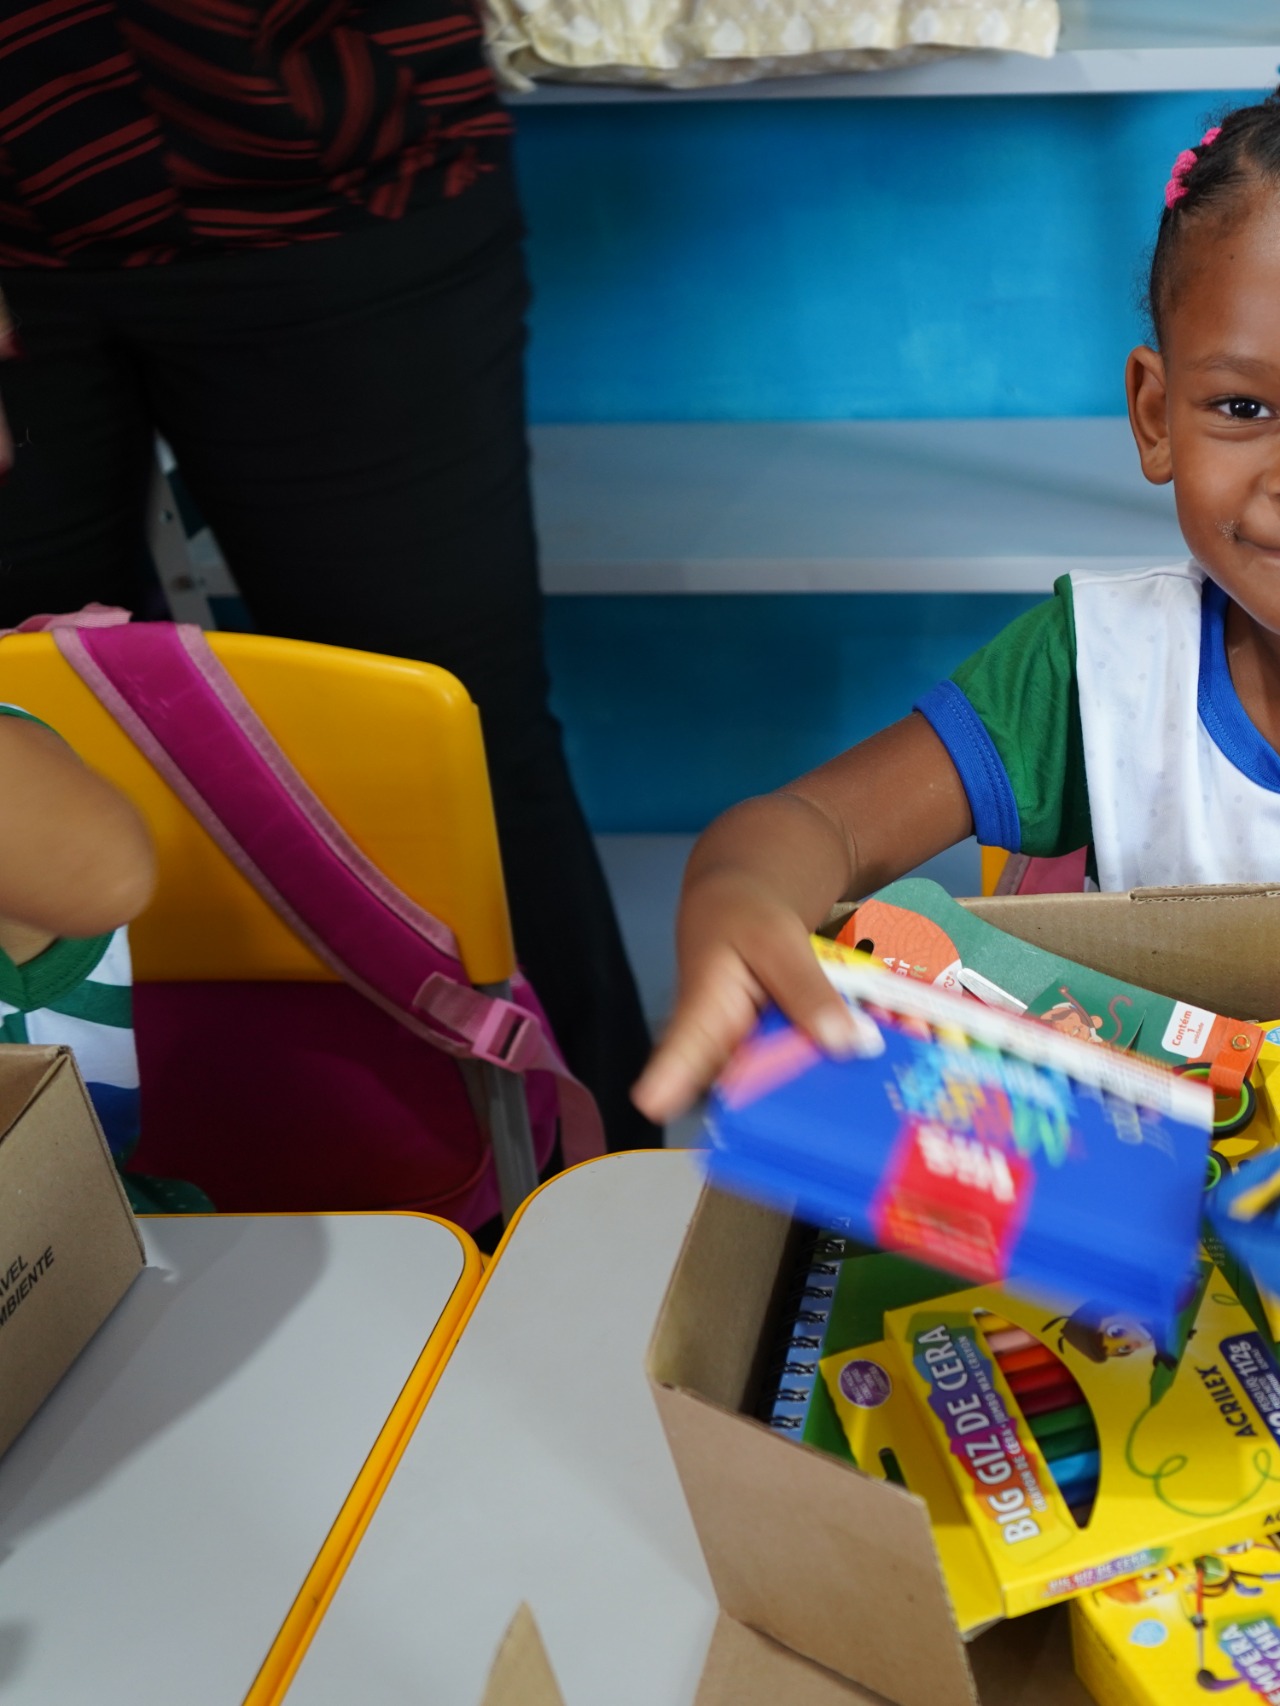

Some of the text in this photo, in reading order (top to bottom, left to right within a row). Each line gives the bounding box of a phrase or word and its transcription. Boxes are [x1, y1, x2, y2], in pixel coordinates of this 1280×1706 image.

[1172, 1010, 1192, 1046] Contém
[958, 1335, 981, 1370] CRAYON
[1194, 1364, 1258, 1437] ACRILEX
[917, 1324, 1041, 1544] BIG GIZ DE CERA
